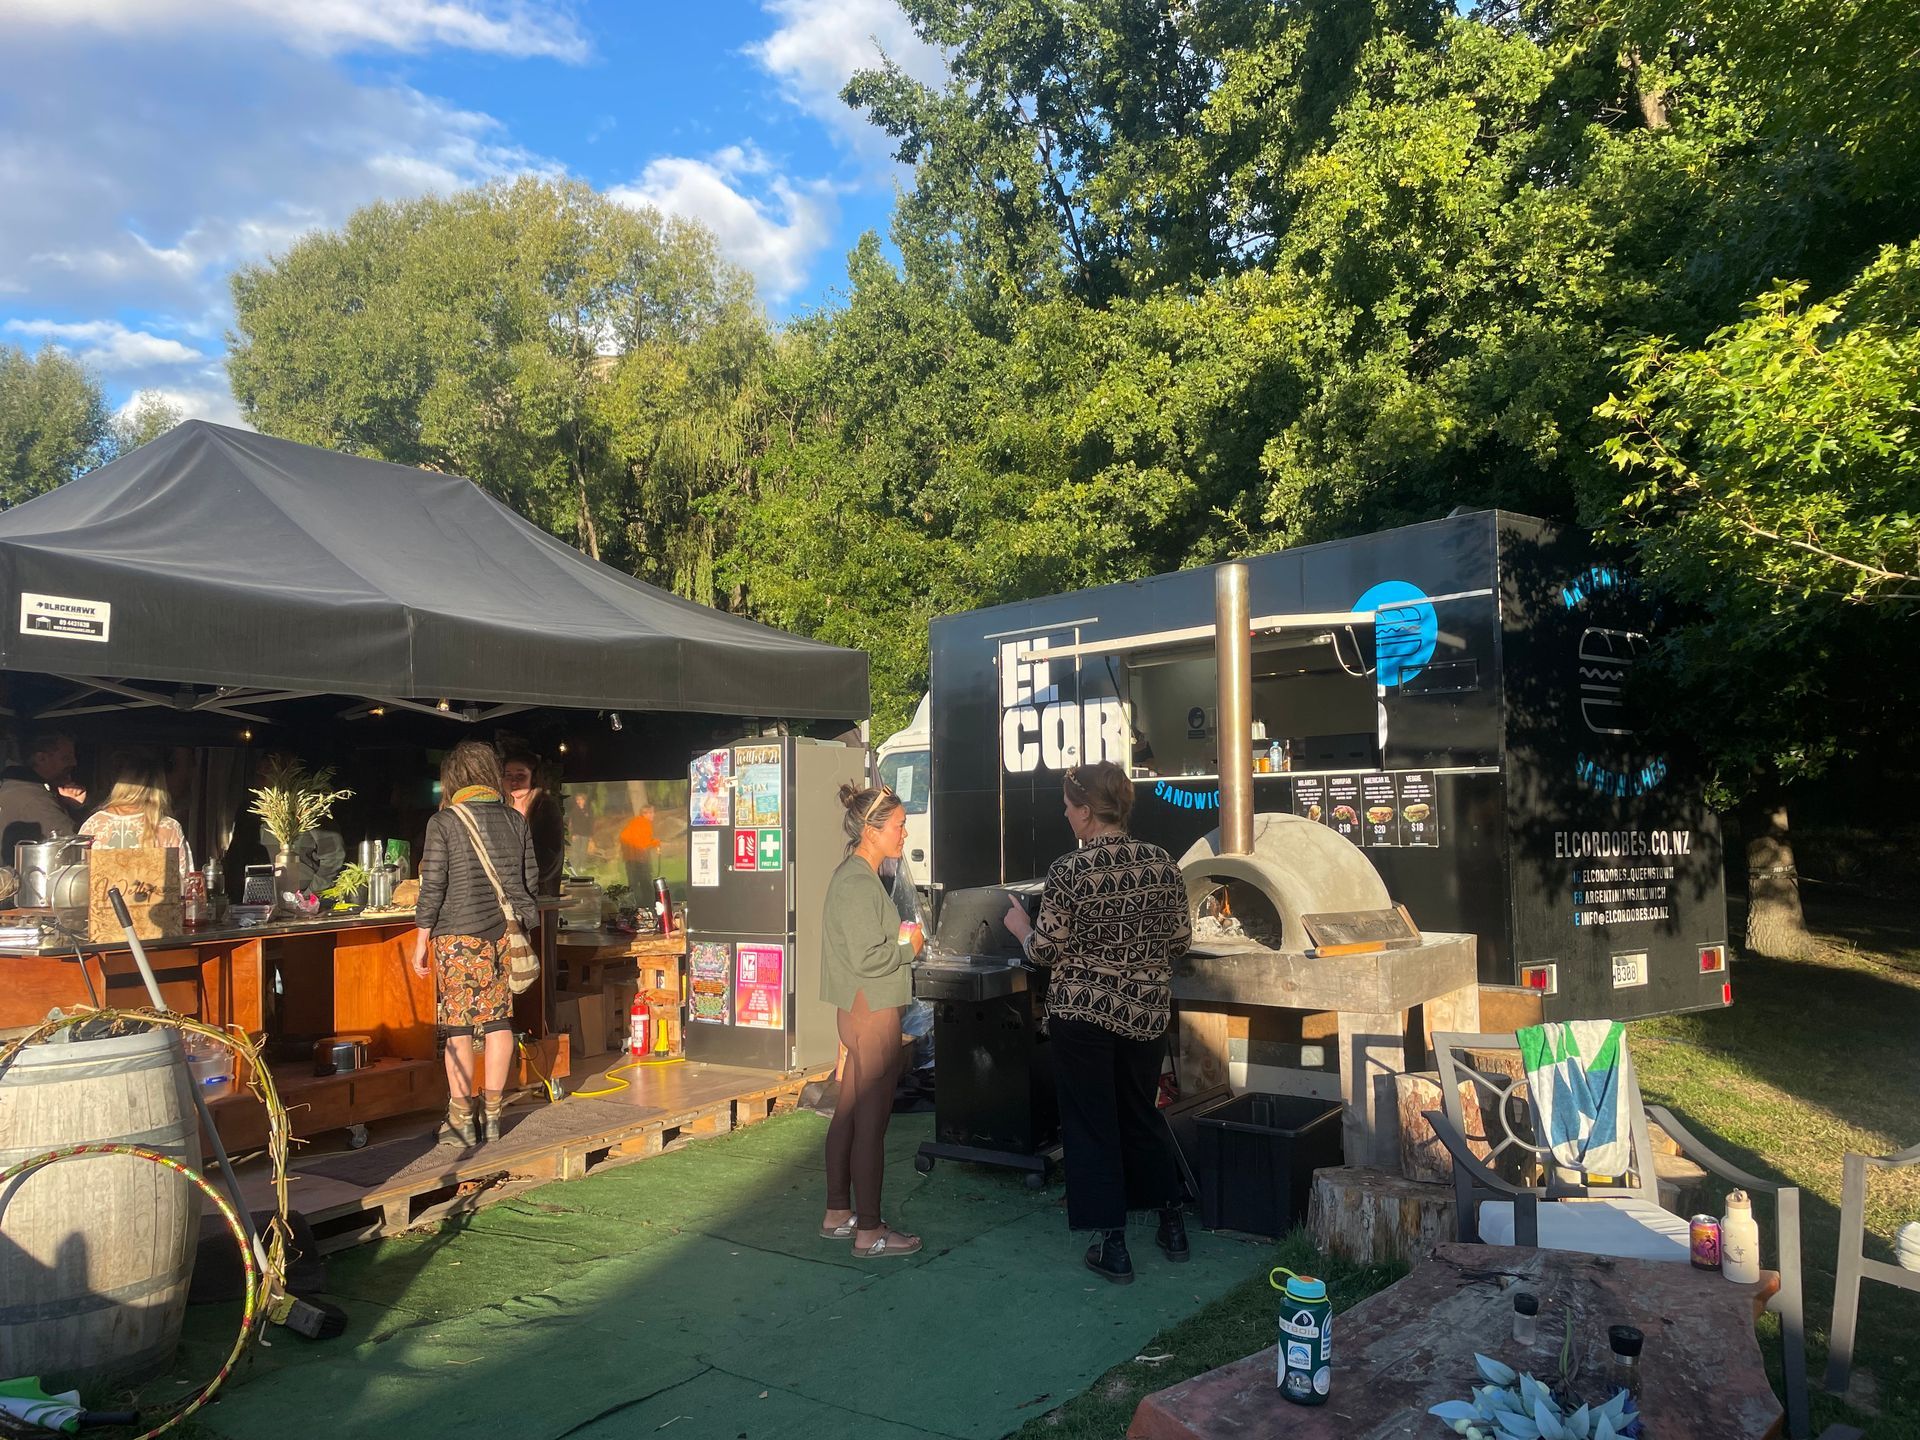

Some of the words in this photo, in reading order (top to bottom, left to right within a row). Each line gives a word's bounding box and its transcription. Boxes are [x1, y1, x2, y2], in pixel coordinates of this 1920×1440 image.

[44, 602, 96, 615] BLACKHAWK
[1001, 636, 1059, 708] EL
[1338, 823, 1351, 833] $18
[1374, 825, 1386, 834] $20
[1411, 822, 1424, 832] $18
[1554, 830, 1691, 858] ELCORDOBES.CO.NZ
[1574, 891, 1584, 905] FB
[1574, 912, 1580, 926] E
[1581, 906, 1670, 926] INFO@ELCORDOBES.CO.NZ
